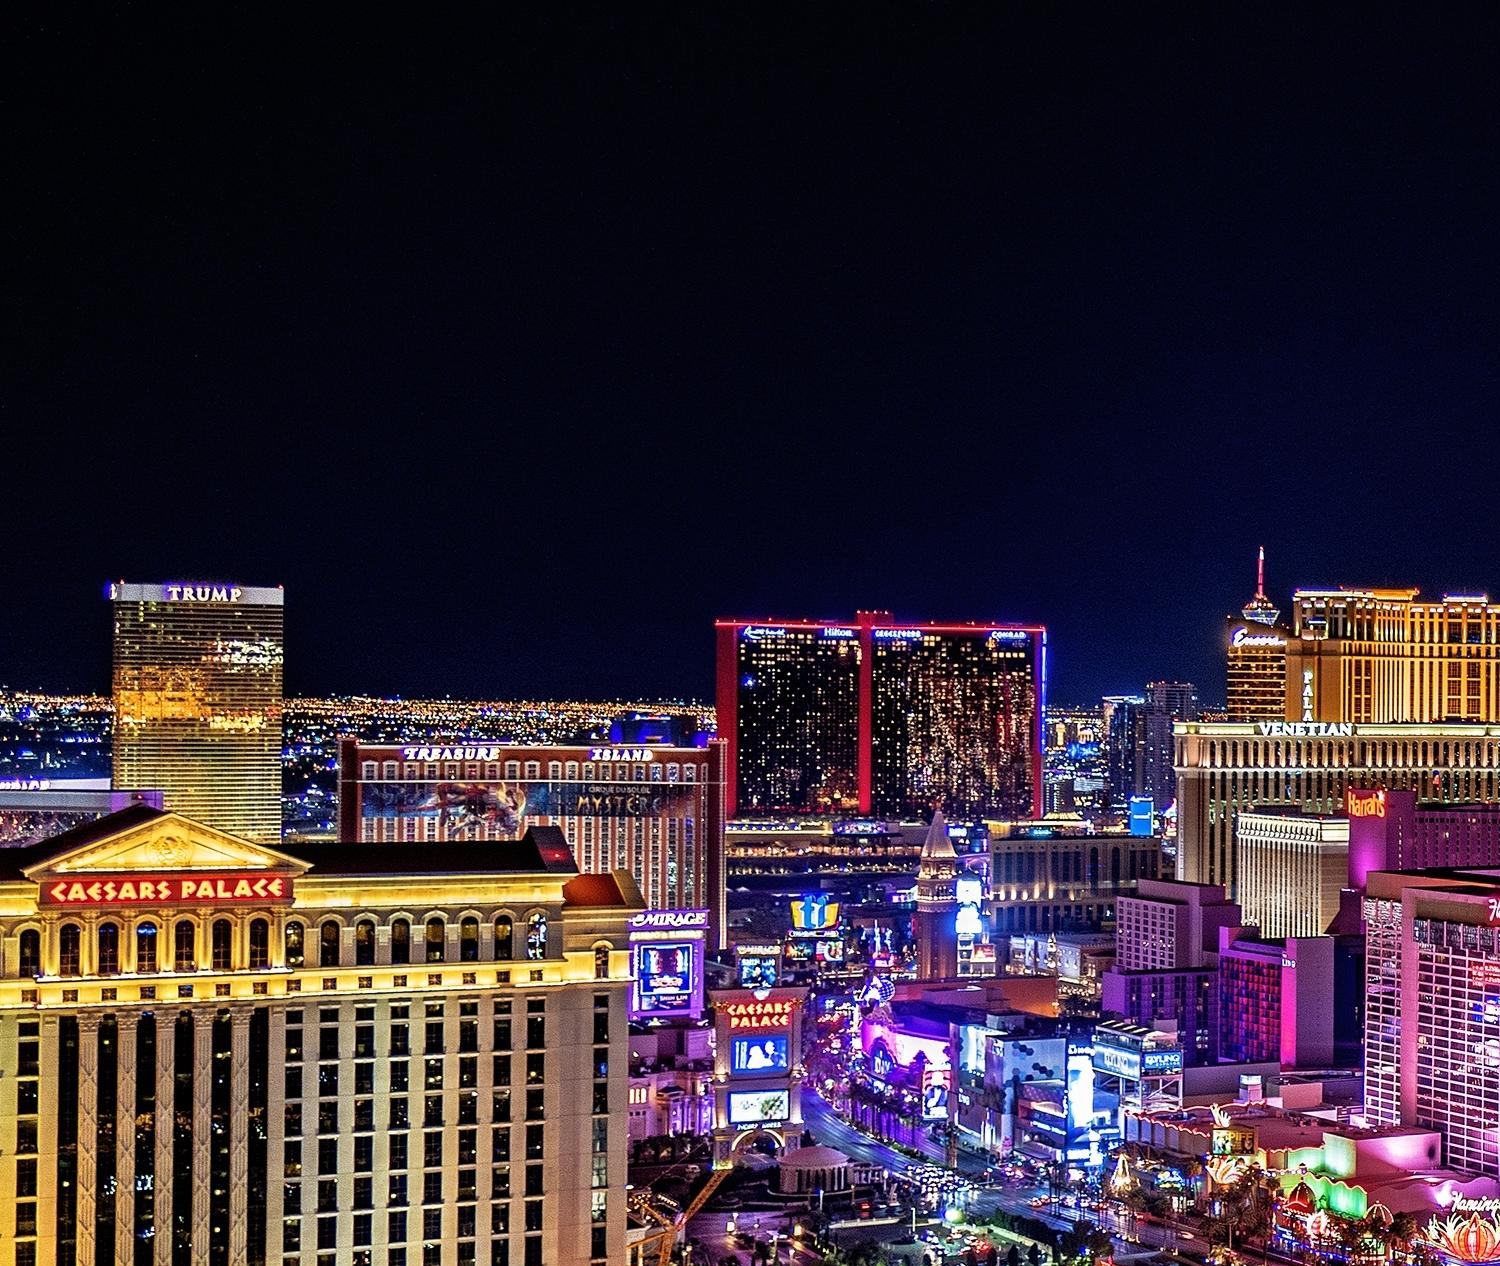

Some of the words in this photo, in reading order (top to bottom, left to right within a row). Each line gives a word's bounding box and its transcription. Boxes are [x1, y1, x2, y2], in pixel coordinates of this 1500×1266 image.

[168, 585, 242, 602] TRUMP
[824, 627, 853, 637] Hilton
[1303, 671, 1314, 722] PALA
[1260, 723, 1353, 736] VENETIAN
[403, 747, 500, 761] TREASURE
[591, 748, 653, 761] ISLAND
[51, 881, 172, 902] CAESARS
[181, 878, 284, 899] PALACE
[640, 913, 706, 926] MIRAGE
[726, 1002, 793, 1016] CAESARS
[731, 1014, 789, 1028] PALACE
